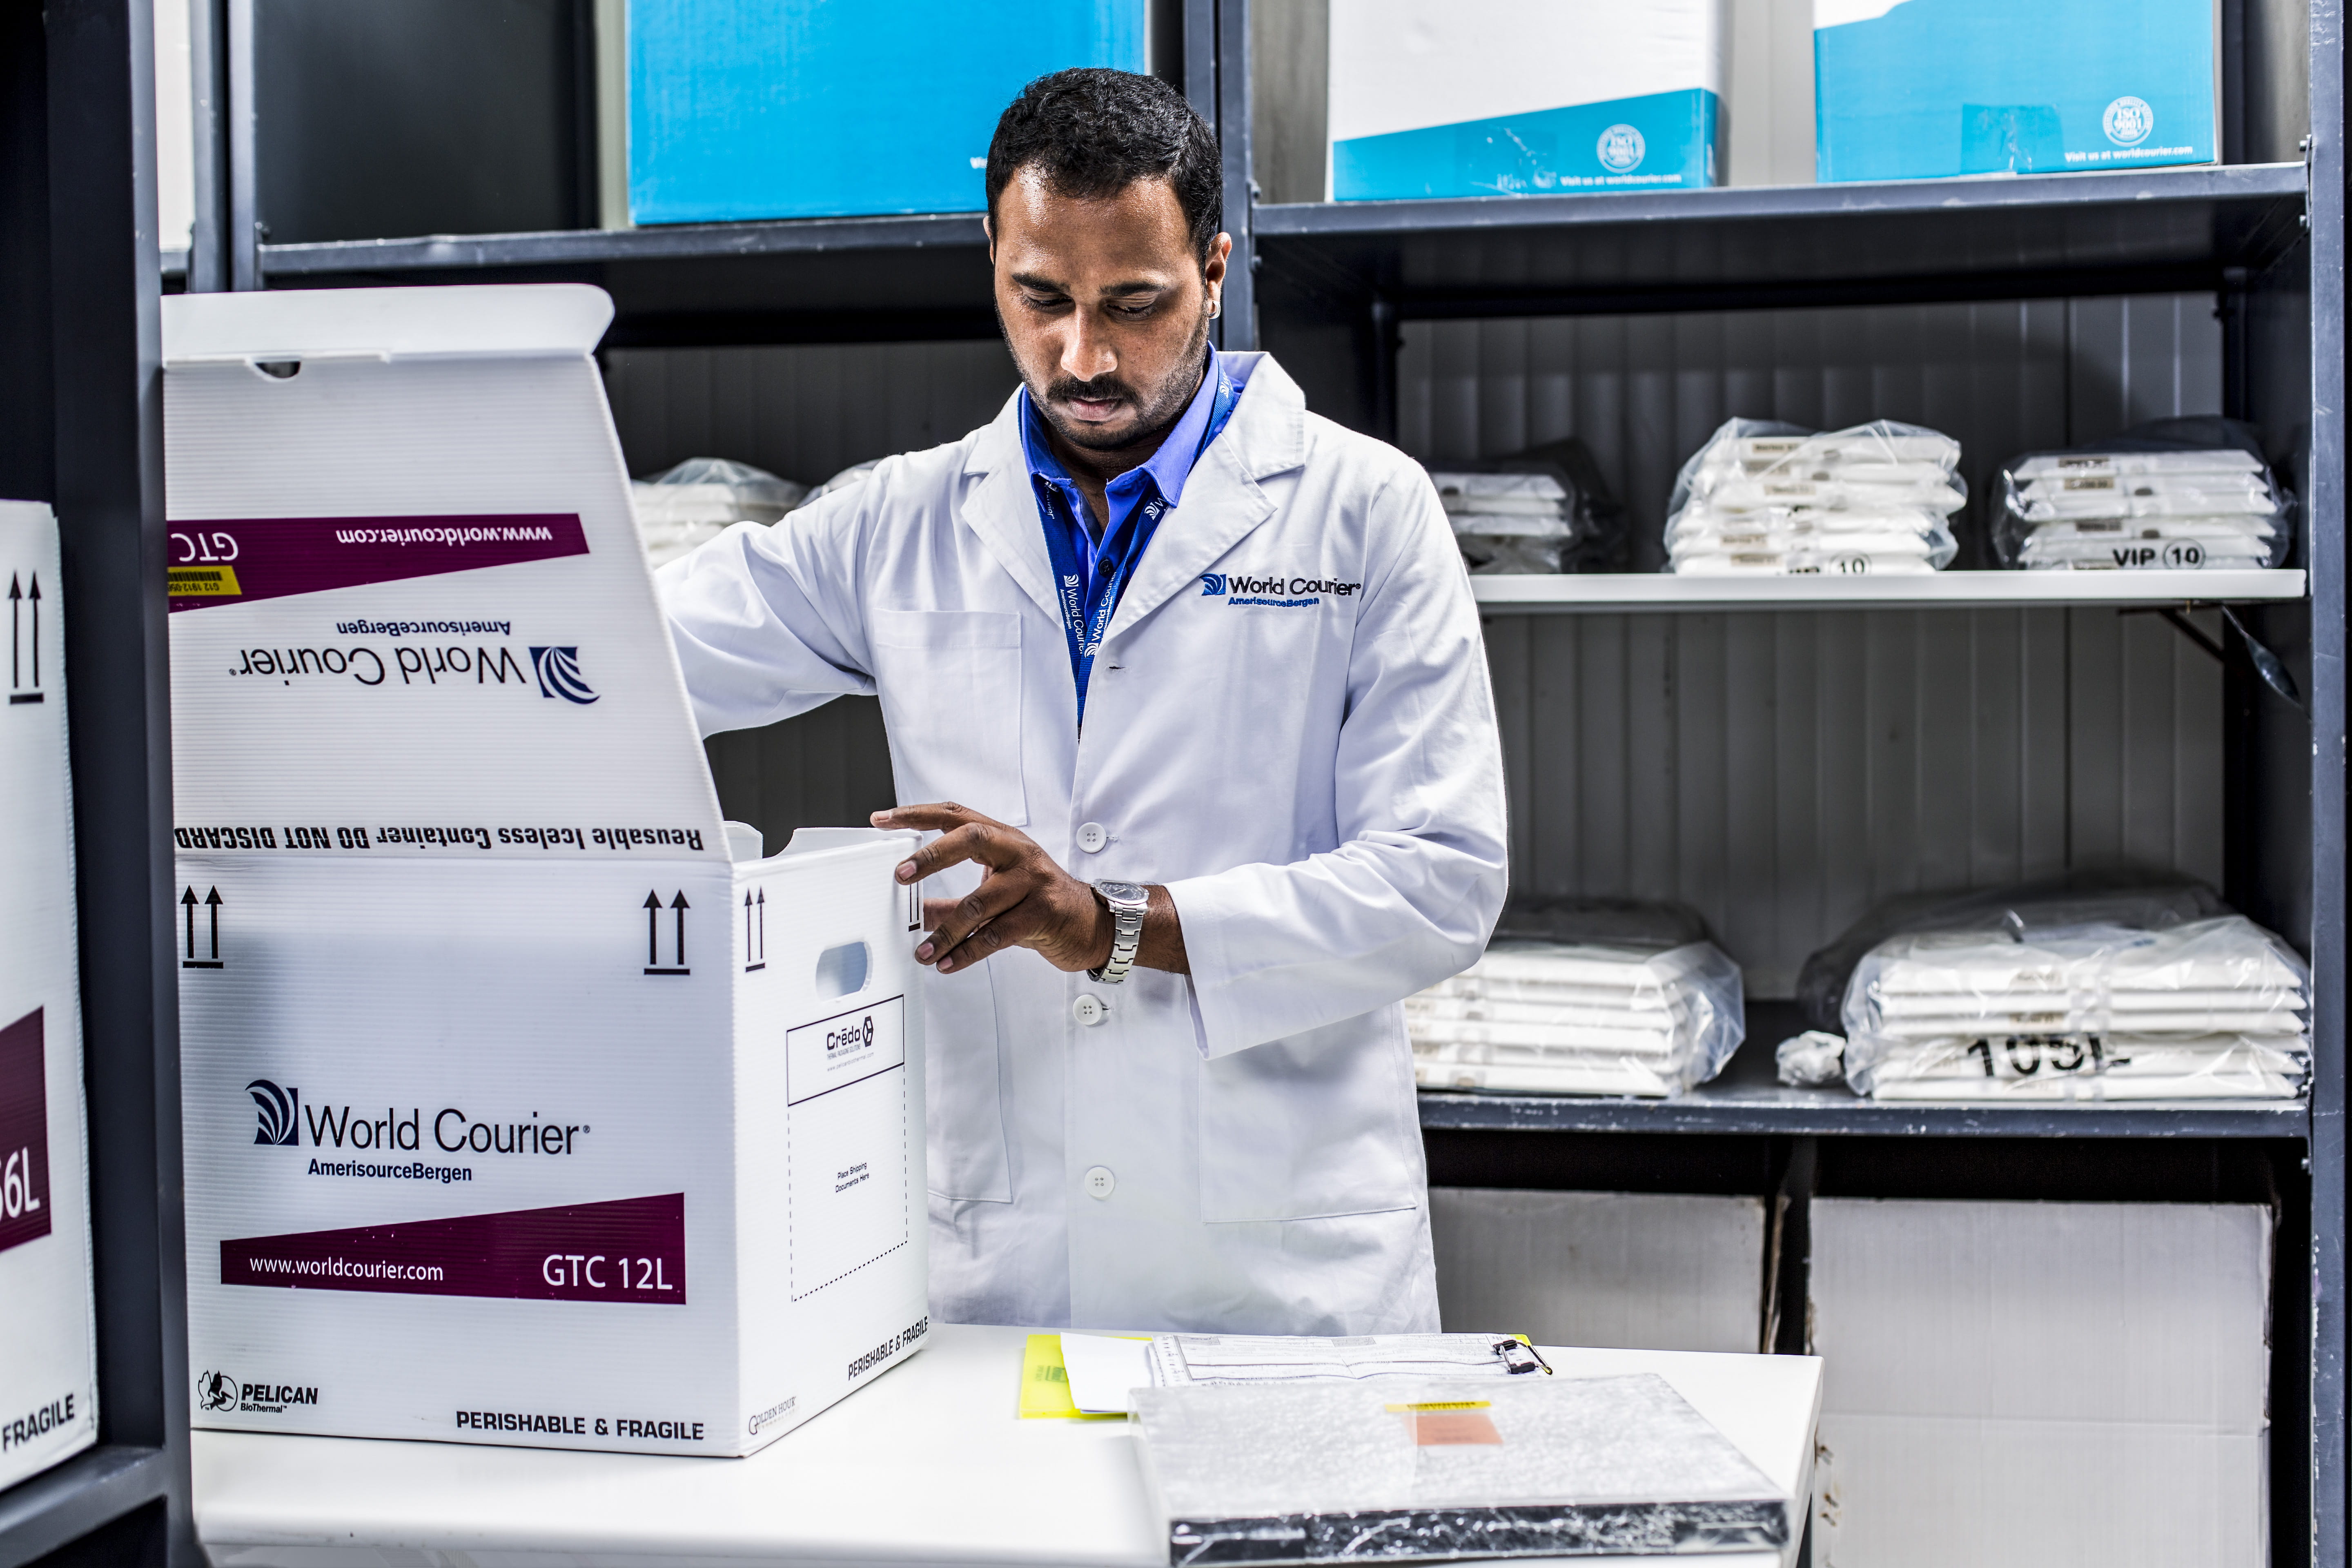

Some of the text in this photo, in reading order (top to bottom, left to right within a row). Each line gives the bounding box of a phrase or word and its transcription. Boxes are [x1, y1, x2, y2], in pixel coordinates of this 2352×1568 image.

[2087, 152, 2099, 161] us
[2100, 151, 2111, 160] at
[2113, 146, 2193, 159] worldcourier.com
[170, 532, 238, 562] GTC
[336, 527, 552, 547] www.worldcourier.com
[2112, 547, 2200, 566] VIP 10
[1228, 576, 1284, 595] World
[1067, 588, 1082, 617] World
[1228, 597, 1319, 607] AmerisourceBergen
[337, 621, 511, 636] AmerisourceBergen
[1091, 610, 1106, 641] World
[394, 646, 527, 684] World
[174, 827, 704, 851] Reusable Iceless Container DO NOT DISCARD
[305, 1105, 420, 1152] World
[0, 1145, 40, 1218] 6L
[308, 1158, 472, 1184] AmerisourceBergen
[835, 1173, 869, 1193] Documents Here
[837, 1162, 867, 1180] Place Shipping
[249, 1256, 444, 1281] www.worldcourier.com
[542, 1254, 673, 1290] GTC 12L
[848, 1315, 928, 1381] PERISHABLE & FRAGILE
[241, 1383, 318, 1405] PELICAN
[2, 1392, 75, 1452] FRAGILE
[456, 1410, 705, 1441] PERISHABLE & FRAGILE
[748, 1406, 777, 1435] GOLDEN
